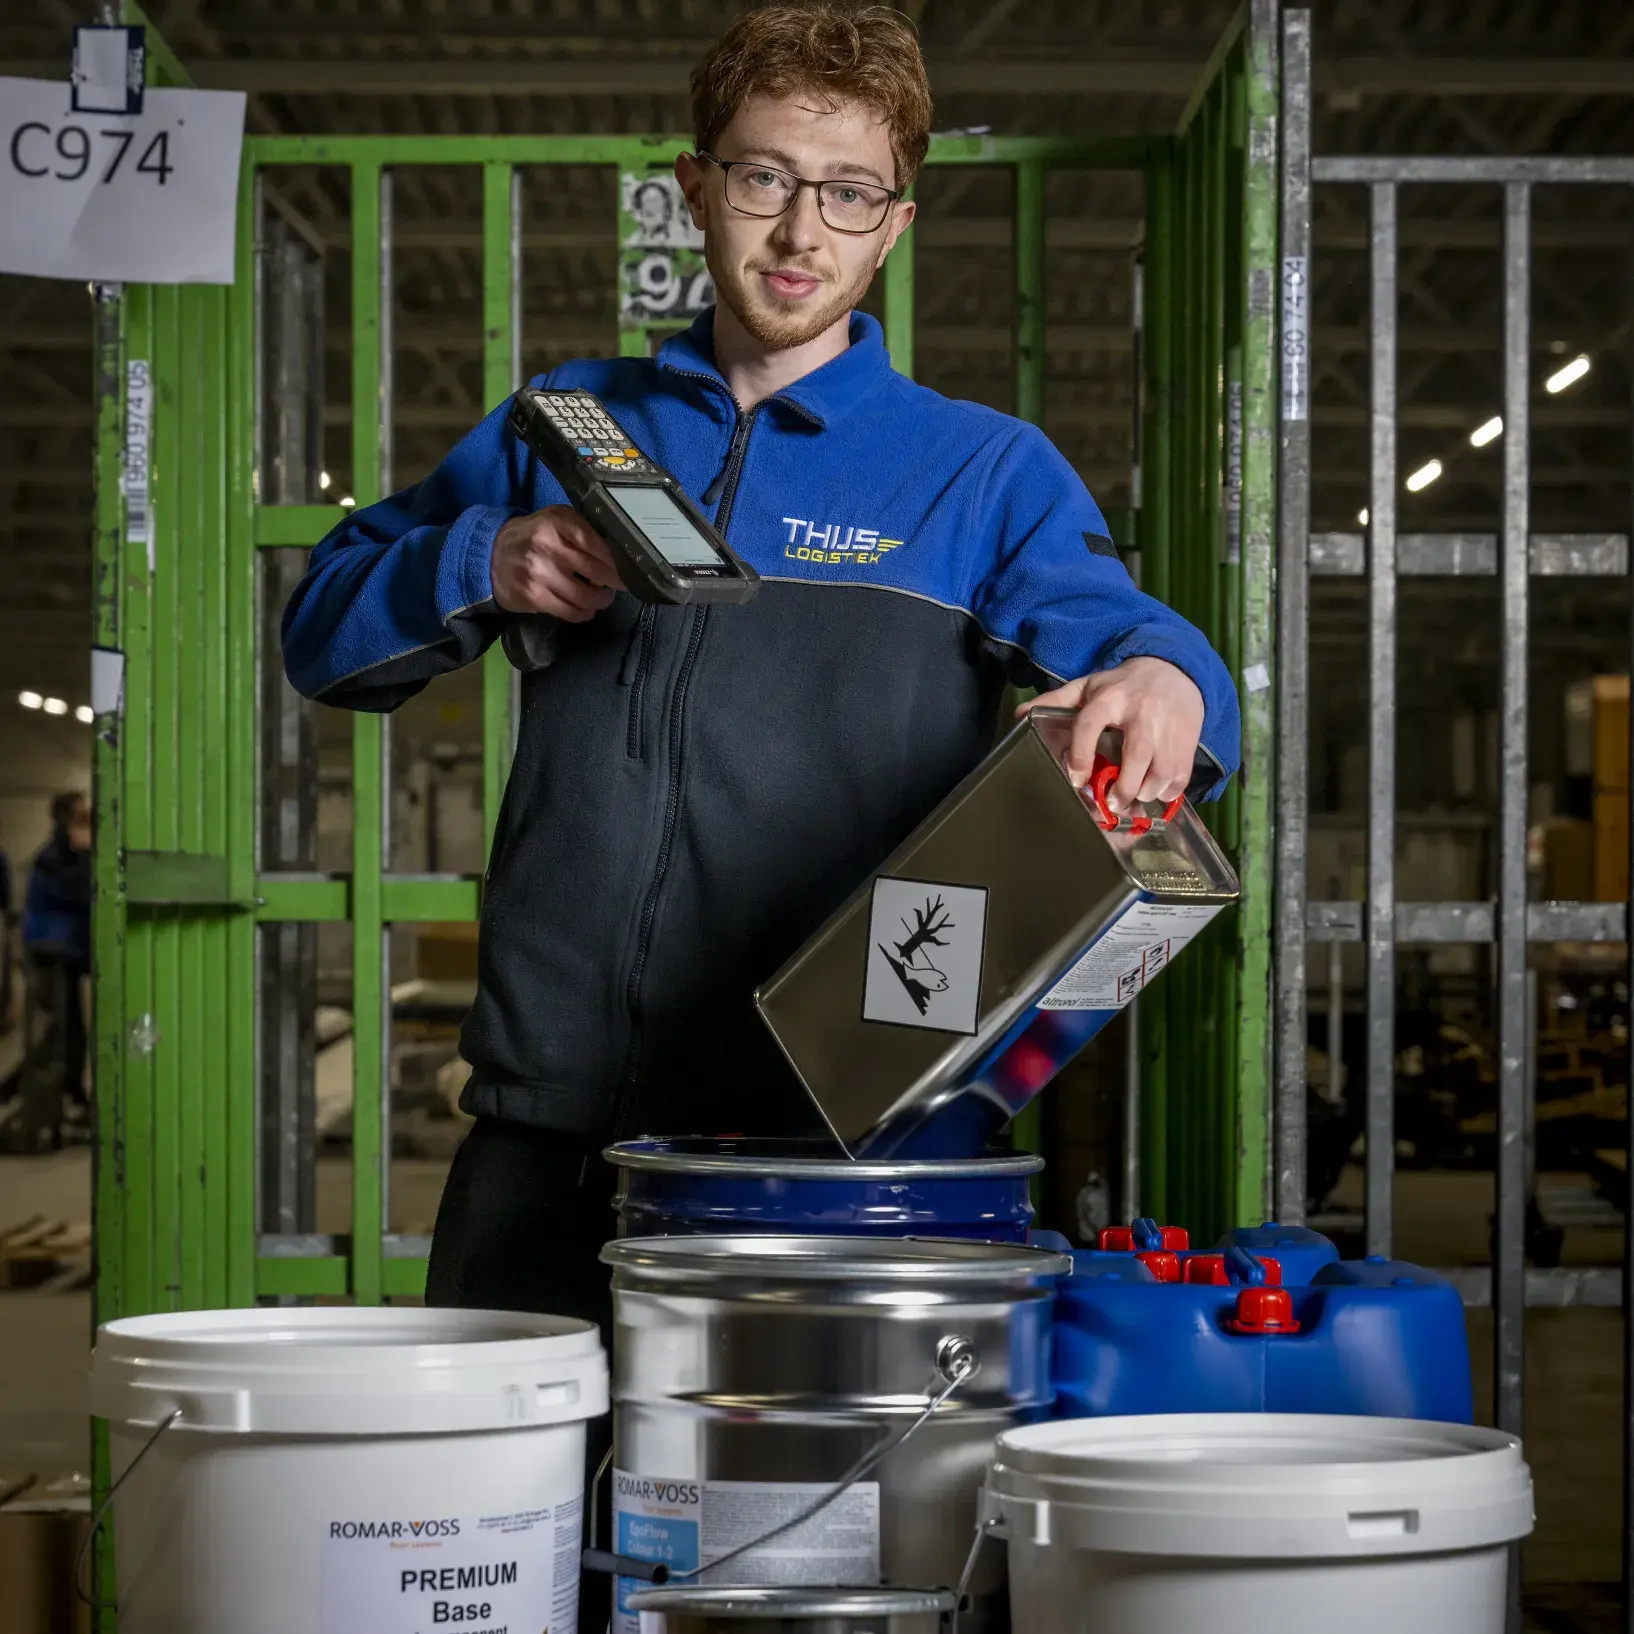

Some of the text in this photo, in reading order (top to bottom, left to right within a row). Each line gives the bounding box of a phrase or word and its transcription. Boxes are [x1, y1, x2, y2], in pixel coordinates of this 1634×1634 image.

[9, 121, 174, 185] C974
[127, 361, 147, 389] 05
[784, 544, 882, 564] LOGISTIEK
[329, 1519, 460, 1539] ROMAR-VOSS
[400, 1561, 517, 1592] PREMIUM
[432, 1601, 492, 1623] Base
